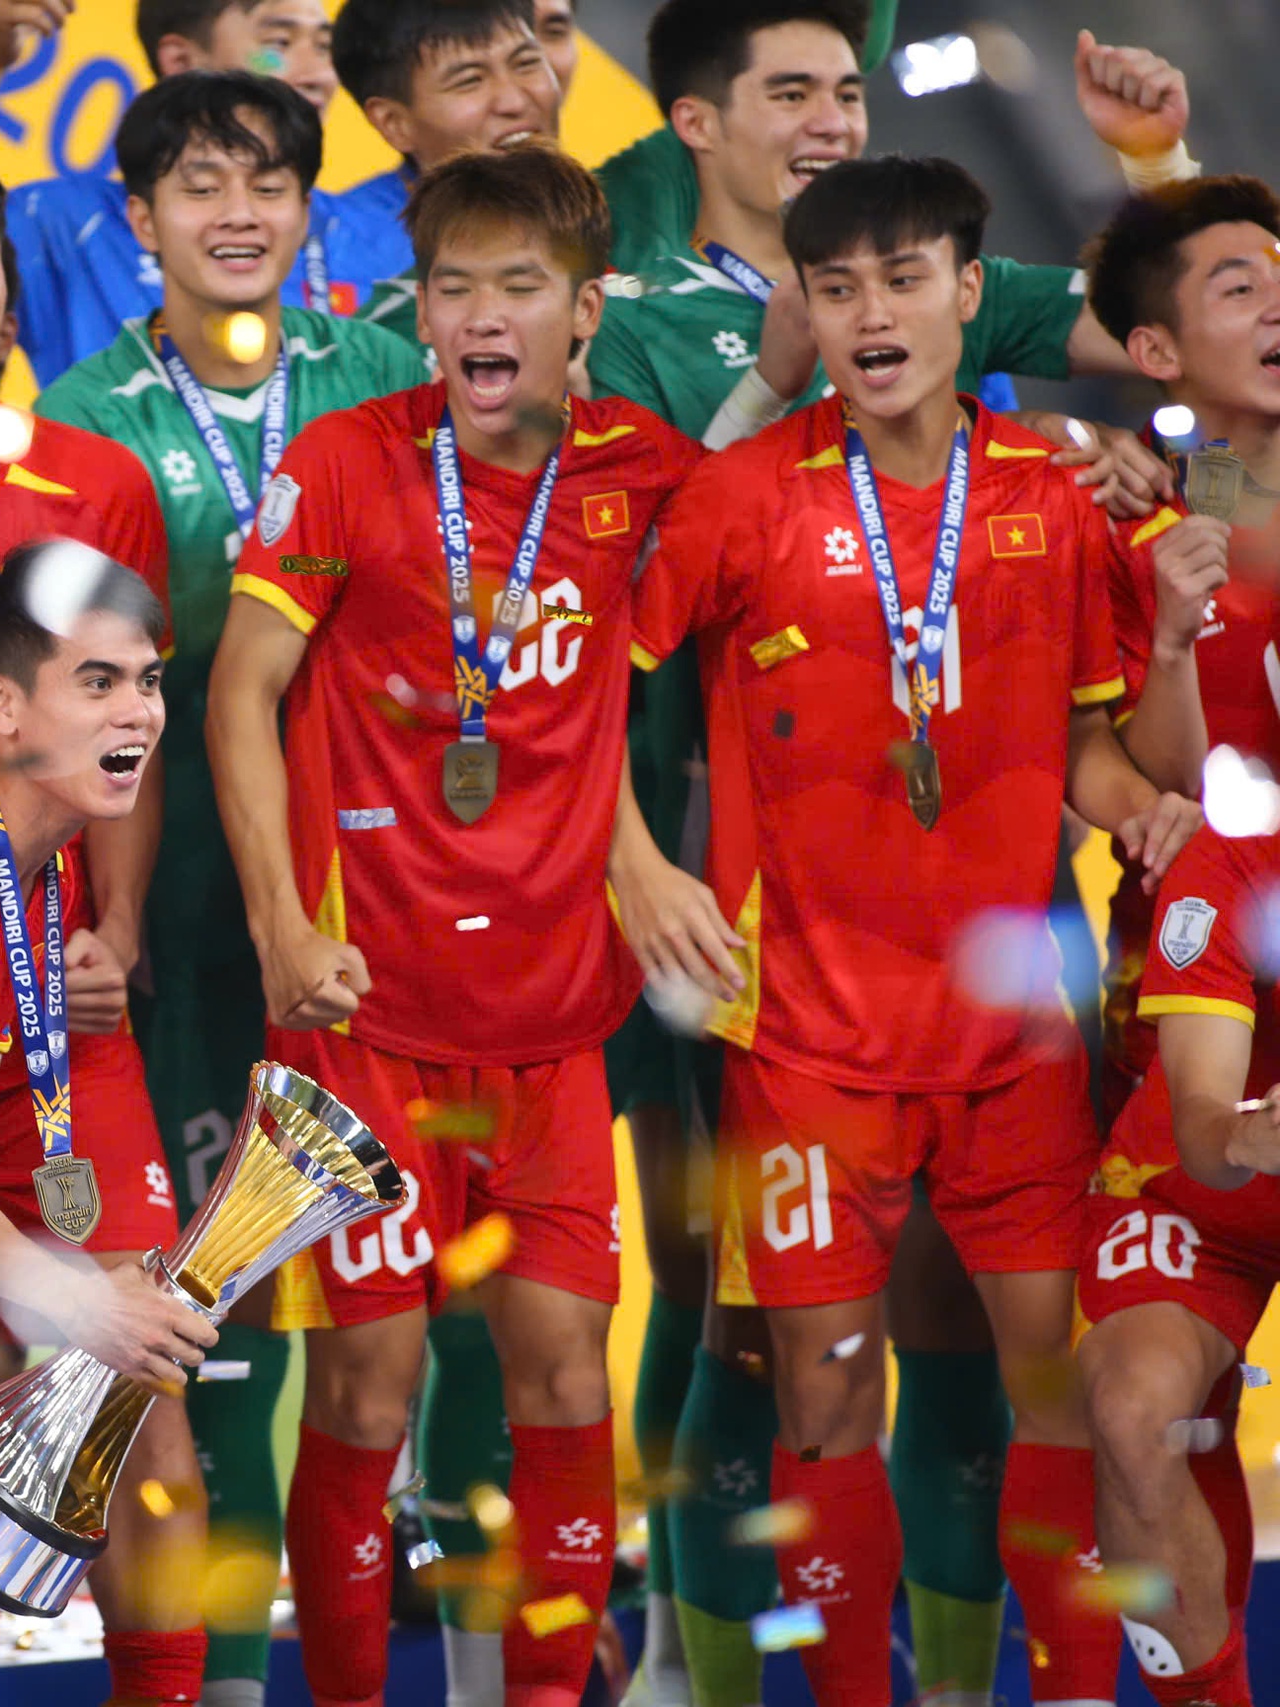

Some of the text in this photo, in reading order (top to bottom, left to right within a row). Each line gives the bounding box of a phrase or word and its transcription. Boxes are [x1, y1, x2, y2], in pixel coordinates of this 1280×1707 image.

[164, 354, 253, 512] MANDIRI CUP 2025
[433, 426, 469, 603] MANDIRI CUP 2025
[498, 455, 559, 626] MANDIRI CUP 2025
[847, 453, 901, 626] MANDIRI CUP 2025
[928, 445, 969, 615] MANDIRI CUP 2025
[493, 577, 583, 691] 22
[8, 945, 32, 988] CUP
[46, 860, 62, 1016] ANDIRI CUP 2025
[17, 990, 41, 1038] 2025
[50, 1157, 73, 1169] ASEAN
[54, 1204, 93, 1221] mandiri
[761, 1142, 833, 1252] 21
[64, 1218, 87, 1230] CUP
[1097, 1210, 1202, 1281] 20
